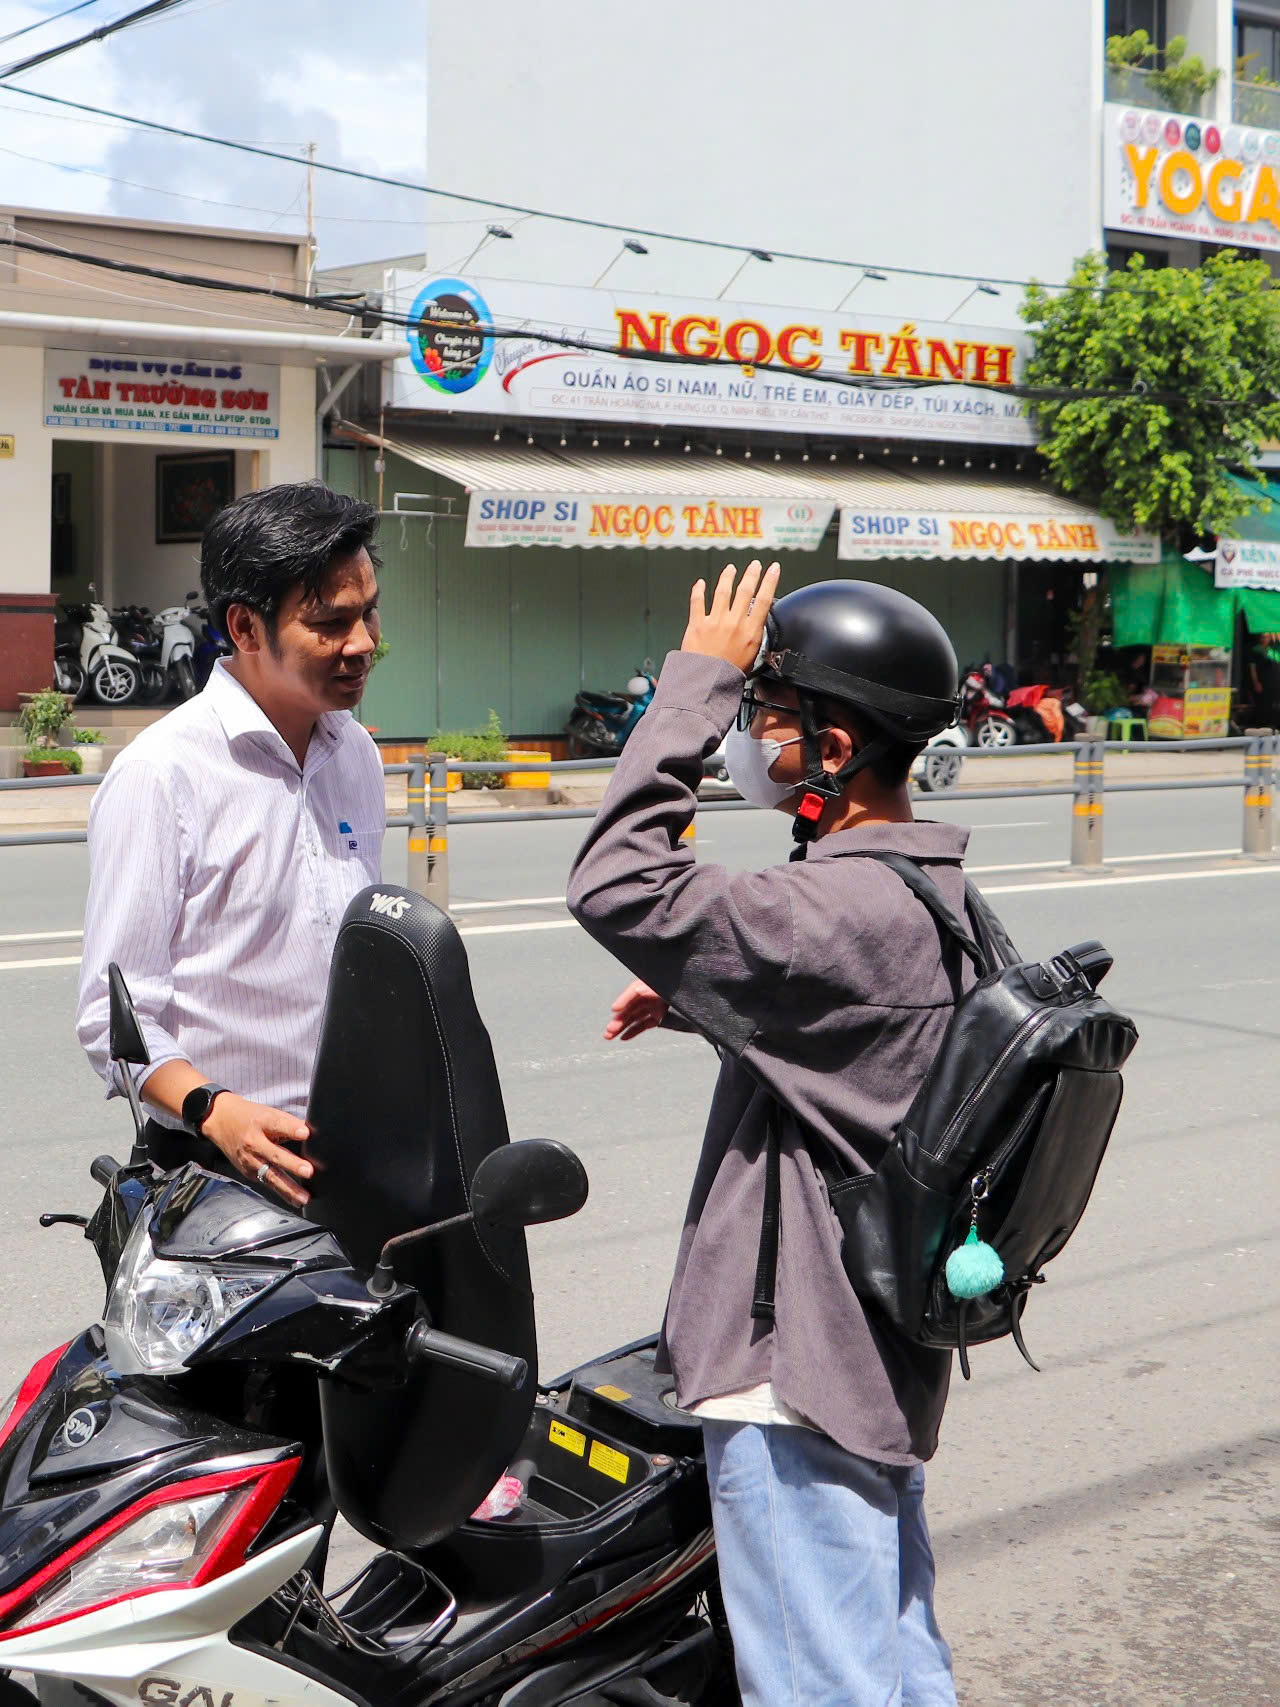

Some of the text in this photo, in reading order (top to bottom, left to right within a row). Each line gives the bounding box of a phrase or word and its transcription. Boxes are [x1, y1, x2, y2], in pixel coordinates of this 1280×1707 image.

[1124, 144, 1280, 231] YOGA
[614, 309, 1016, 385] NGỌC TÁNH
[116, 379, 217, 408] TRƯỜNG
[221, 388, 269, 411] SƠN
[563, 367, 617, 389] QUẦN
[623, 371, 650, 393] ÁO
[655, 377, 671, 394] SI
[114, 407, 134, 416] MUA
[159, 409, 170, 419] XE
[480, 498, 579, 521] SHOP SI
[588, 500, 764, 545] NGỌC TÁNH
[852, 515, 939, 535] SHOP SI
[948, 519, 1101, 556] NGỌC TÁNH
[66, 1417, 92, 1439] SYM
